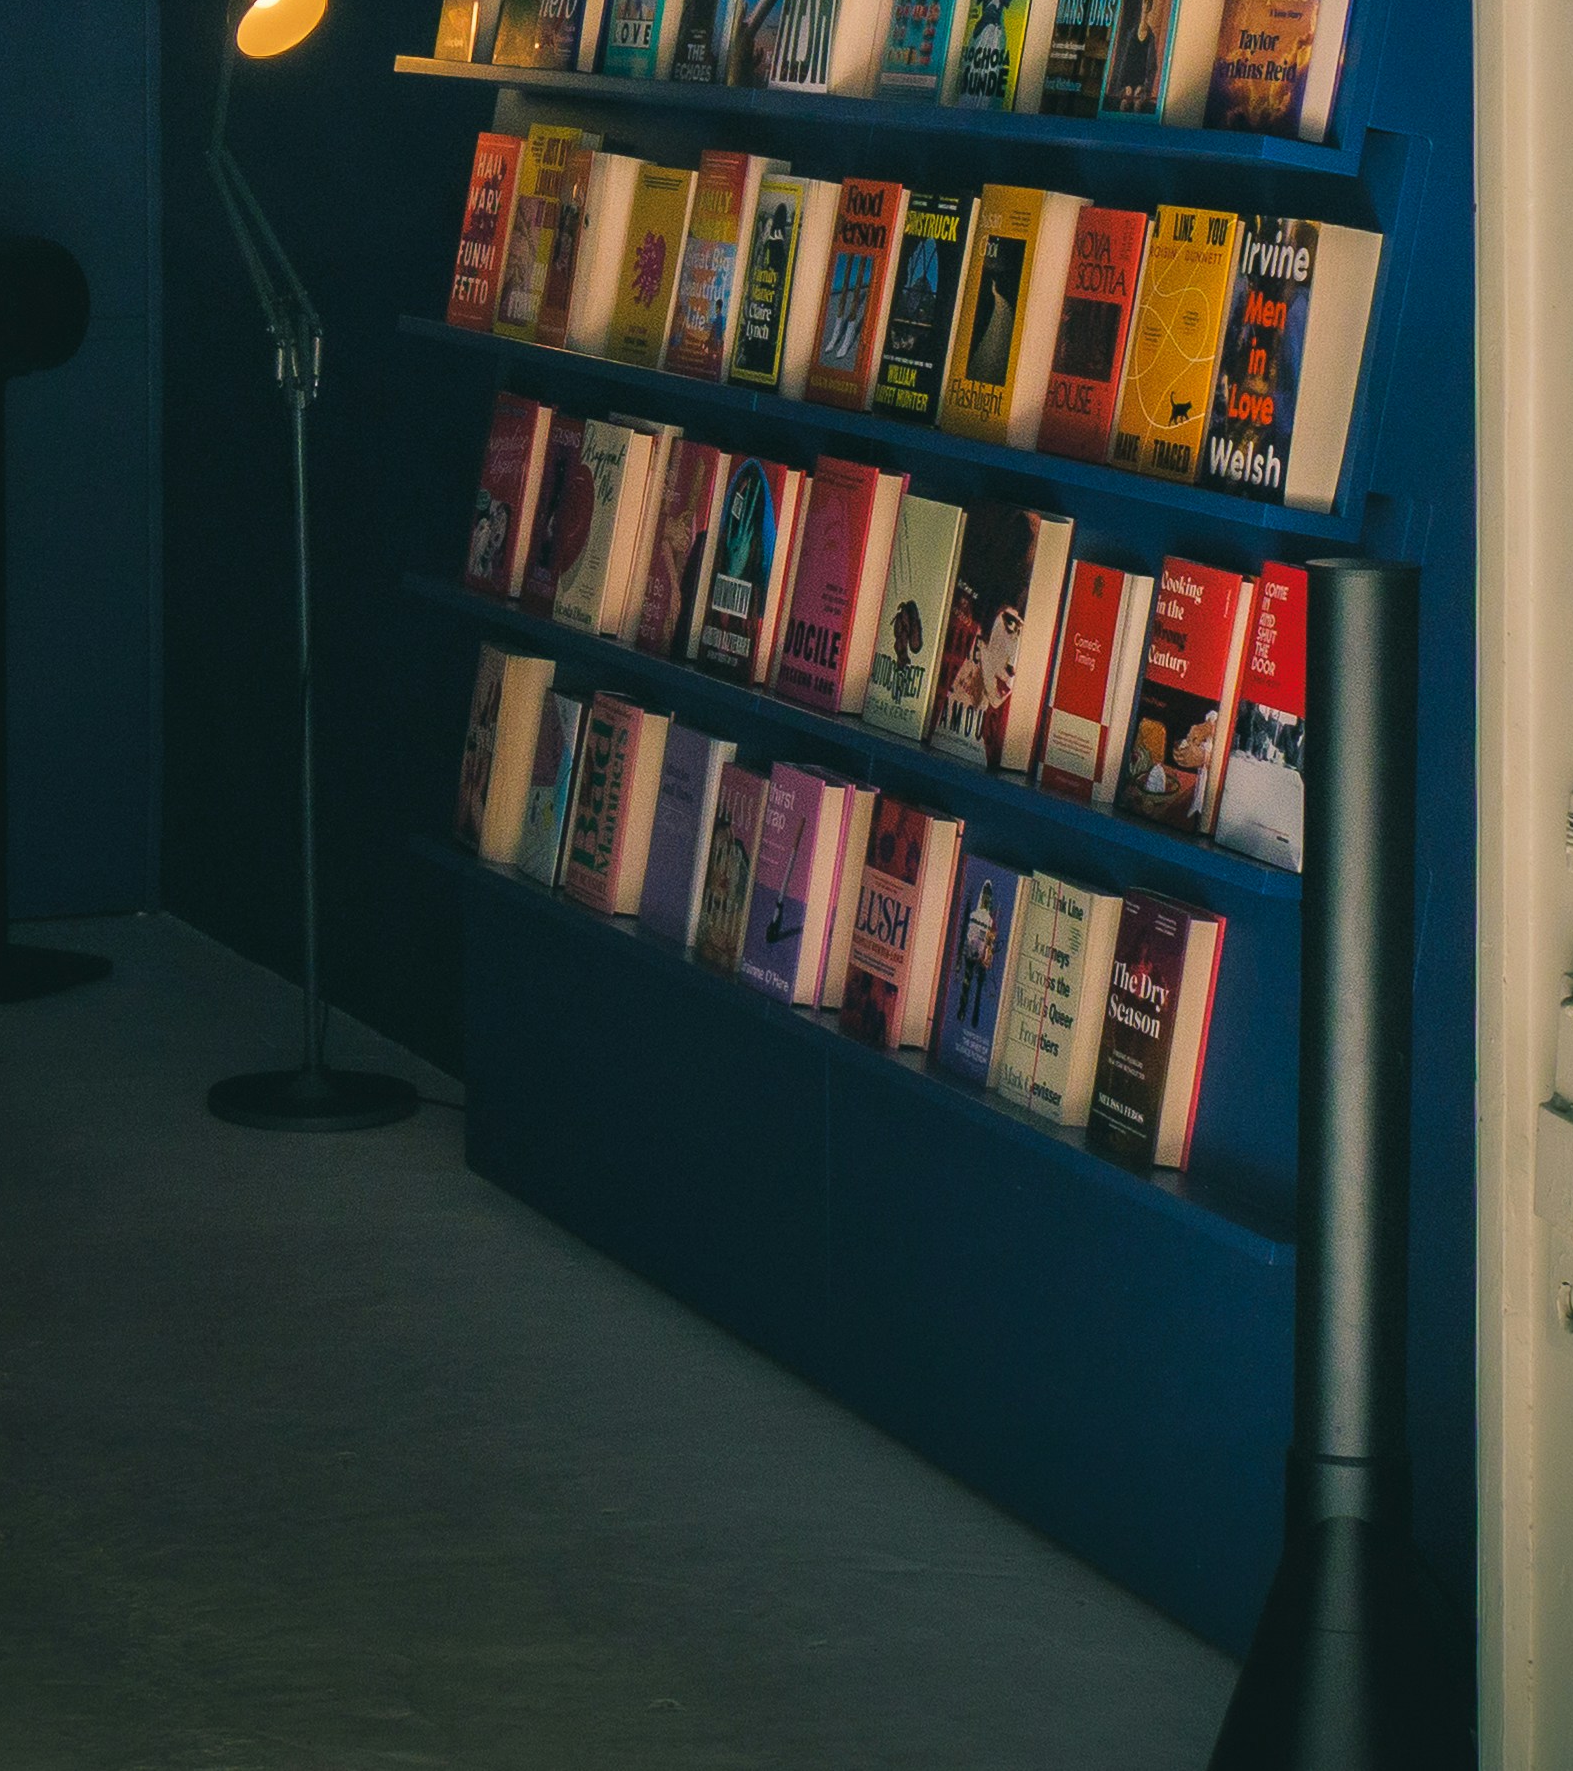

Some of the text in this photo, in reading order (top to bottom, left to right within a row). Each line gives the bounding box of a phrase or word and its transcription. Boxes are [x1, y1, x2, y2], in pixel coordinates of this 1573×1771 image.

[688, 43, 707, 62] THE
[1237, 28, 1280, 53] Taylor
[1264, 59, 1298, 82] Reid
[477, 152, 505, 180] HAIL
[469, 186, 503, 215] MARY
[846, 183, 885, 218] Food
[838, 216, 887, 250] Person
[1076, 230, 1112, 260] NOVA
[1174, 213, 1196, 243] LINE
[1205, 216, 1229, 247] YOU
[457, 239, 496, 272] FUNMI
[1242, 230, 1310, 282] Irvine
[451, 273, 489, 306] FETTO
[1075, 262, 1127, 297] SCOTIA
[748, 302, 773, 322] Claire
[1244, 290, 1287, 330] Men
[745, 321, 770, 341] Lynch
[1248, 337, 1267, 376] in
[949, 378, 1004, 422] Flashlight
[1047, 380, 1094, 415] HOUSE
[1228, 383, 1274, 425] Love
[1151, 438, 1191, 472] TRACED
[1210, 435, 1281, 488] Welsh
[1161, 569, 1205, 605] Cooking
[1260, 597, 1271, 611] IN
[1264, 581, 1290, 603] COME
[1156, 593, 1186, 621] in the
[1258, 613, 1276, 629] AND
[784, 618, 841, 670] DOCILE
[1074, 632, 1102, 655] Comedic
[1254, 641, 1270, 659] THE
[1255, 626, 1278, 646] SHUT
[1074, 651, 1097, 672] Timing
[1147, 643, 1191, 679] Century
[1250, 657, 1277, 678] DOOR
[1029, 878, 1084, 922] The Pink Line
[857, 885, 913, 951] LUSH
[1032, 933, 1071, 969] Journeys
[1025, 961, 1071, 998] Across the
[1112, 960, 1170, 1012] The Dry
[1049, 1003, 1074, 1030] Queer
[1108, 992, 1162, 1040] Season
[1017, 1020, 1060, 1057] Frontiers
[1001, 1062, 1024, 1090] Mark
